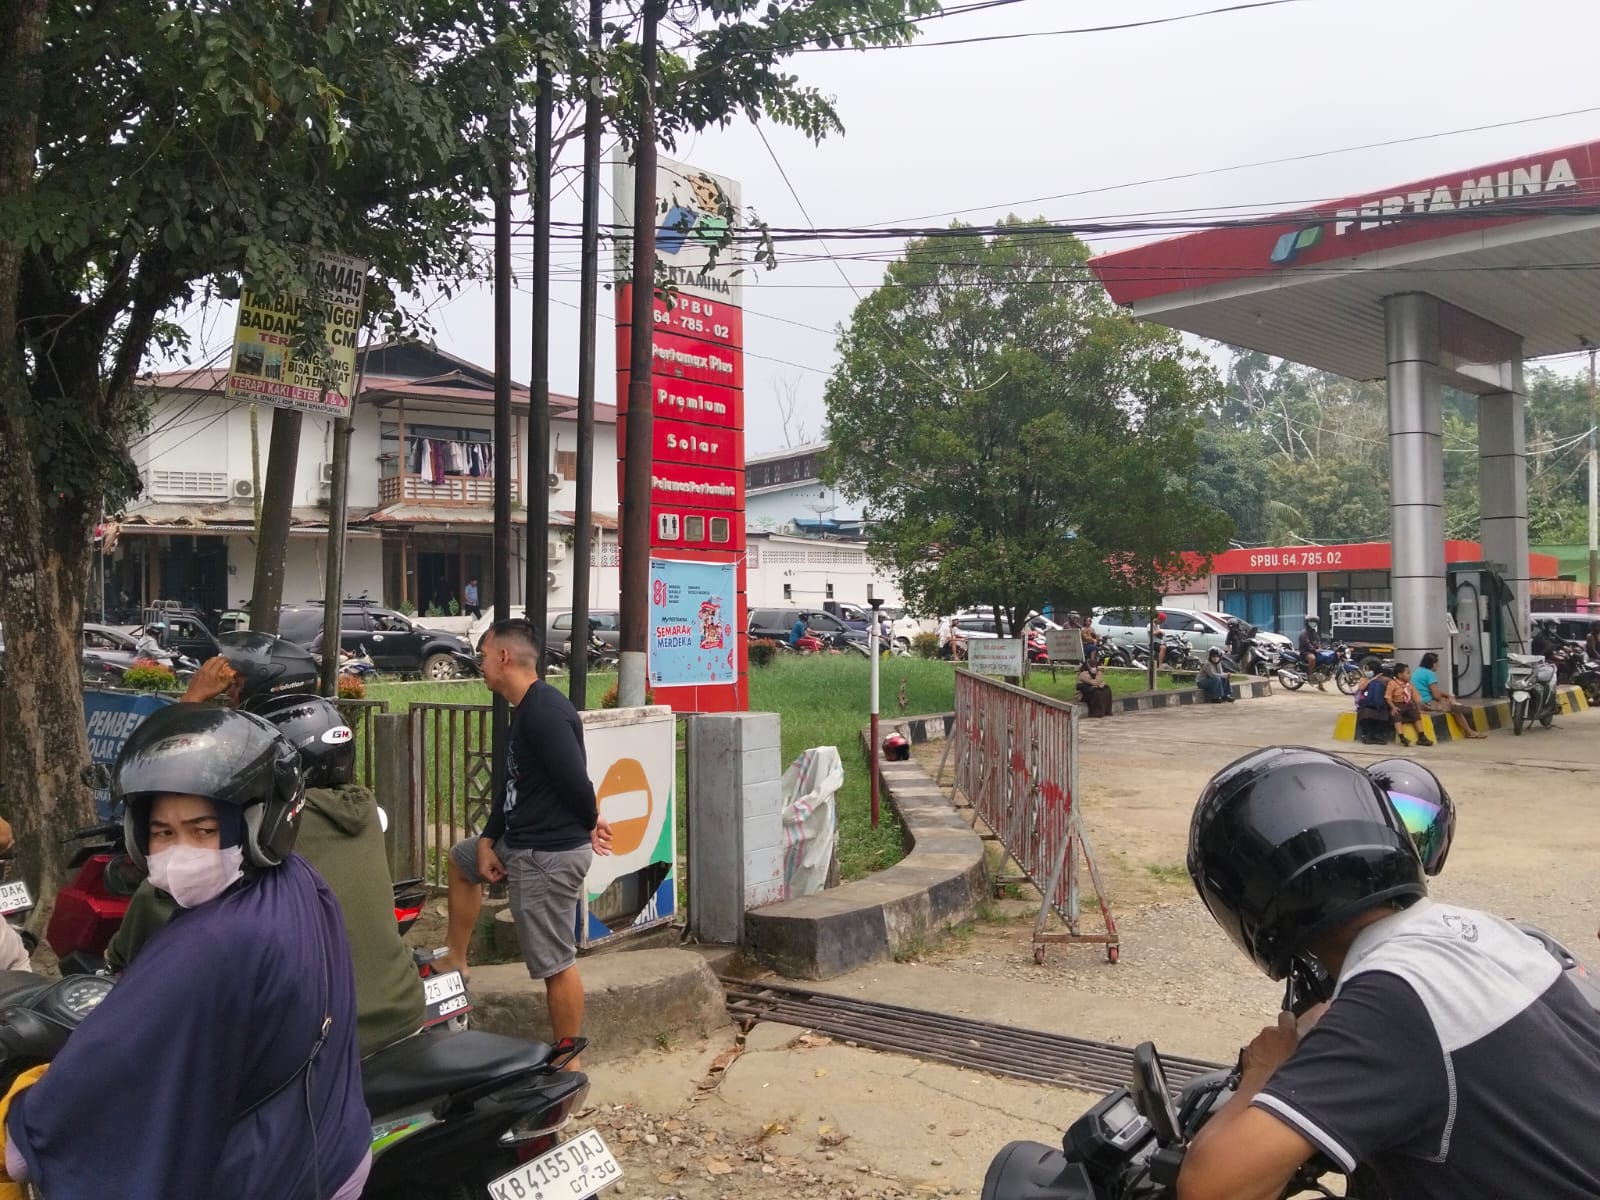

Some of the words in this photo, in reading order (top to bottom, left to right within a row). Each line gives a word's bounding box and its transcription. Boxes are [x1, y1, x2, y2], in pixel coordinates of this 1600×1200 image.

[1335, 158, 1577, 236] PERTAMINA
[240, 309, 298, 335] BADAN
[331, 329, 357, 348] CM
[287, 361, 310, 376] BISA
[652, 343, 707, 369] Pertamax
[709, 355, 733, 373] Plus
[233, 377, 265, 393] TERAPI
[267, 382, 290, 398] KAKI
[291, 388, 321, 402] LETER
[294, 375, 303, 386] DI
[657, 388, 726, 415] Premium
[667, 433, 719, 454] Solar
[656, 625, 692, 638] SEMARAK
[657, 636, 692, 649] MERDEKA
[87, 710, 146, 738] PEMBE
[1, 884, 24, 897] DAK
[494, 1177, 526, 1200] KB
[526, 1152, 570, 1189] 4155
[567, 1134, 604, 1166] DAJ
